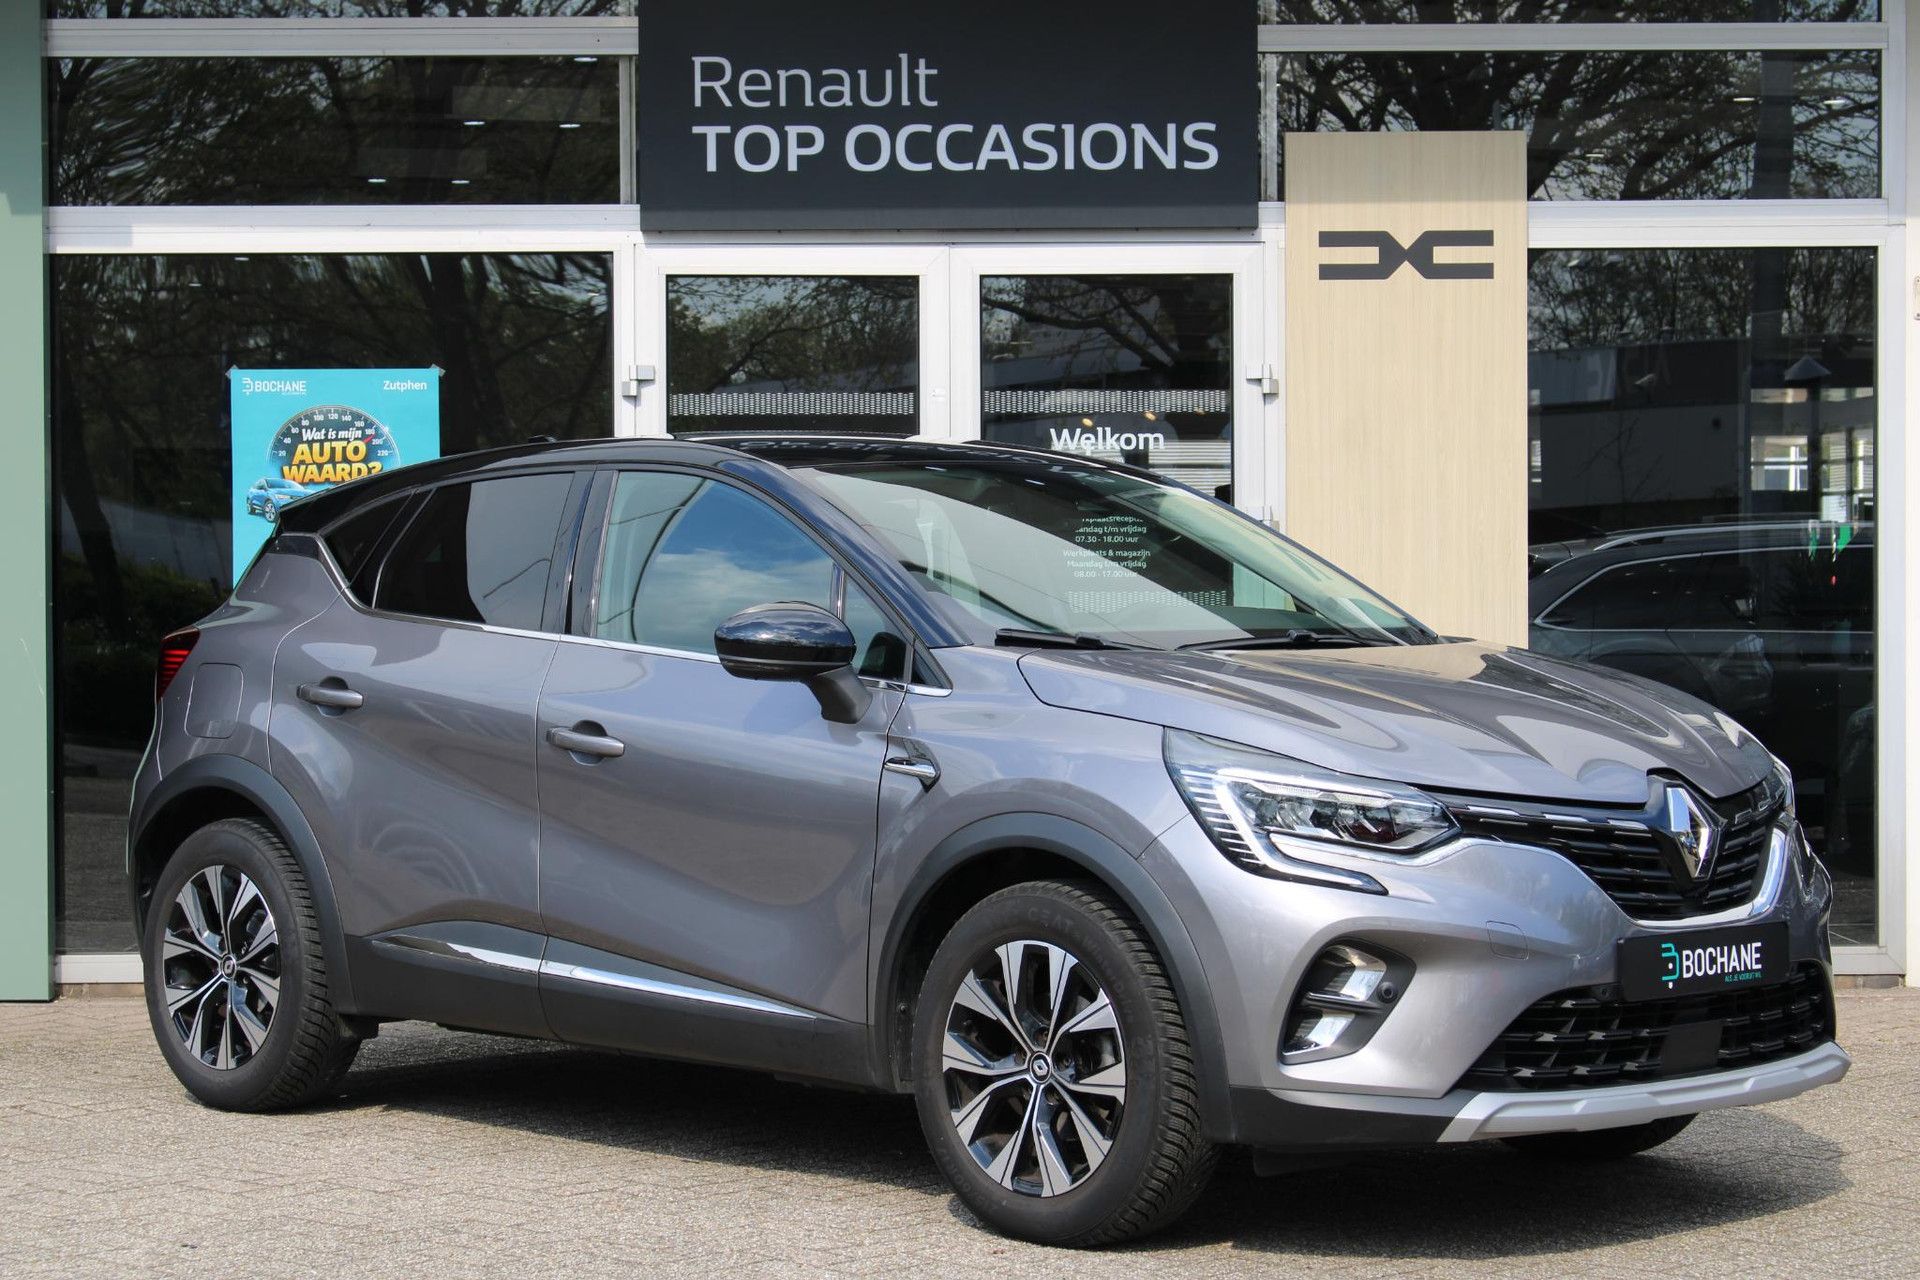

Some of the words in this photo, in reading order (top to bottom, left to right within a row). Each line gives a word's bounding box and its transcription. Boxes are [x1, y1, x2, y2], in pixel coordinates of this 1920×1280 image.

[692, 52, 939, 107] Renault
[691, 124, 825, 172] TOP
[845, 121, 1220, 172] OCCASIONS
[254, 380, 307, 392] BOCHANE
[383, 379, 428, 392] Zutphen
[301, 427, 327, 441] Wat
[327, 428, 337, 440] is
[337, 427, 362, 442] mijn
[1049, 426, 1165, 451] Welkom
[292, 440, 366, 465] AUTO
[282, 461, 382, 483] WAARD?
[1075, 525, 1103, 534] andag
[1104, 525, 1119, 534] t/m
[1120, 524, 1147, 534] vrijdag
[1075, 535, 1097, 543] 07.30
[1103, 535, 1124, 543] 18.00
[1063, 549, 1107, 558] Werkplaats
[1108, 549, 1114, 557] &
[1115, 548, 1151, 559] magazijn
[1120, 560, 1147, 569] vrijdag
[1682, 942, 1762, 979] BOCHANE
